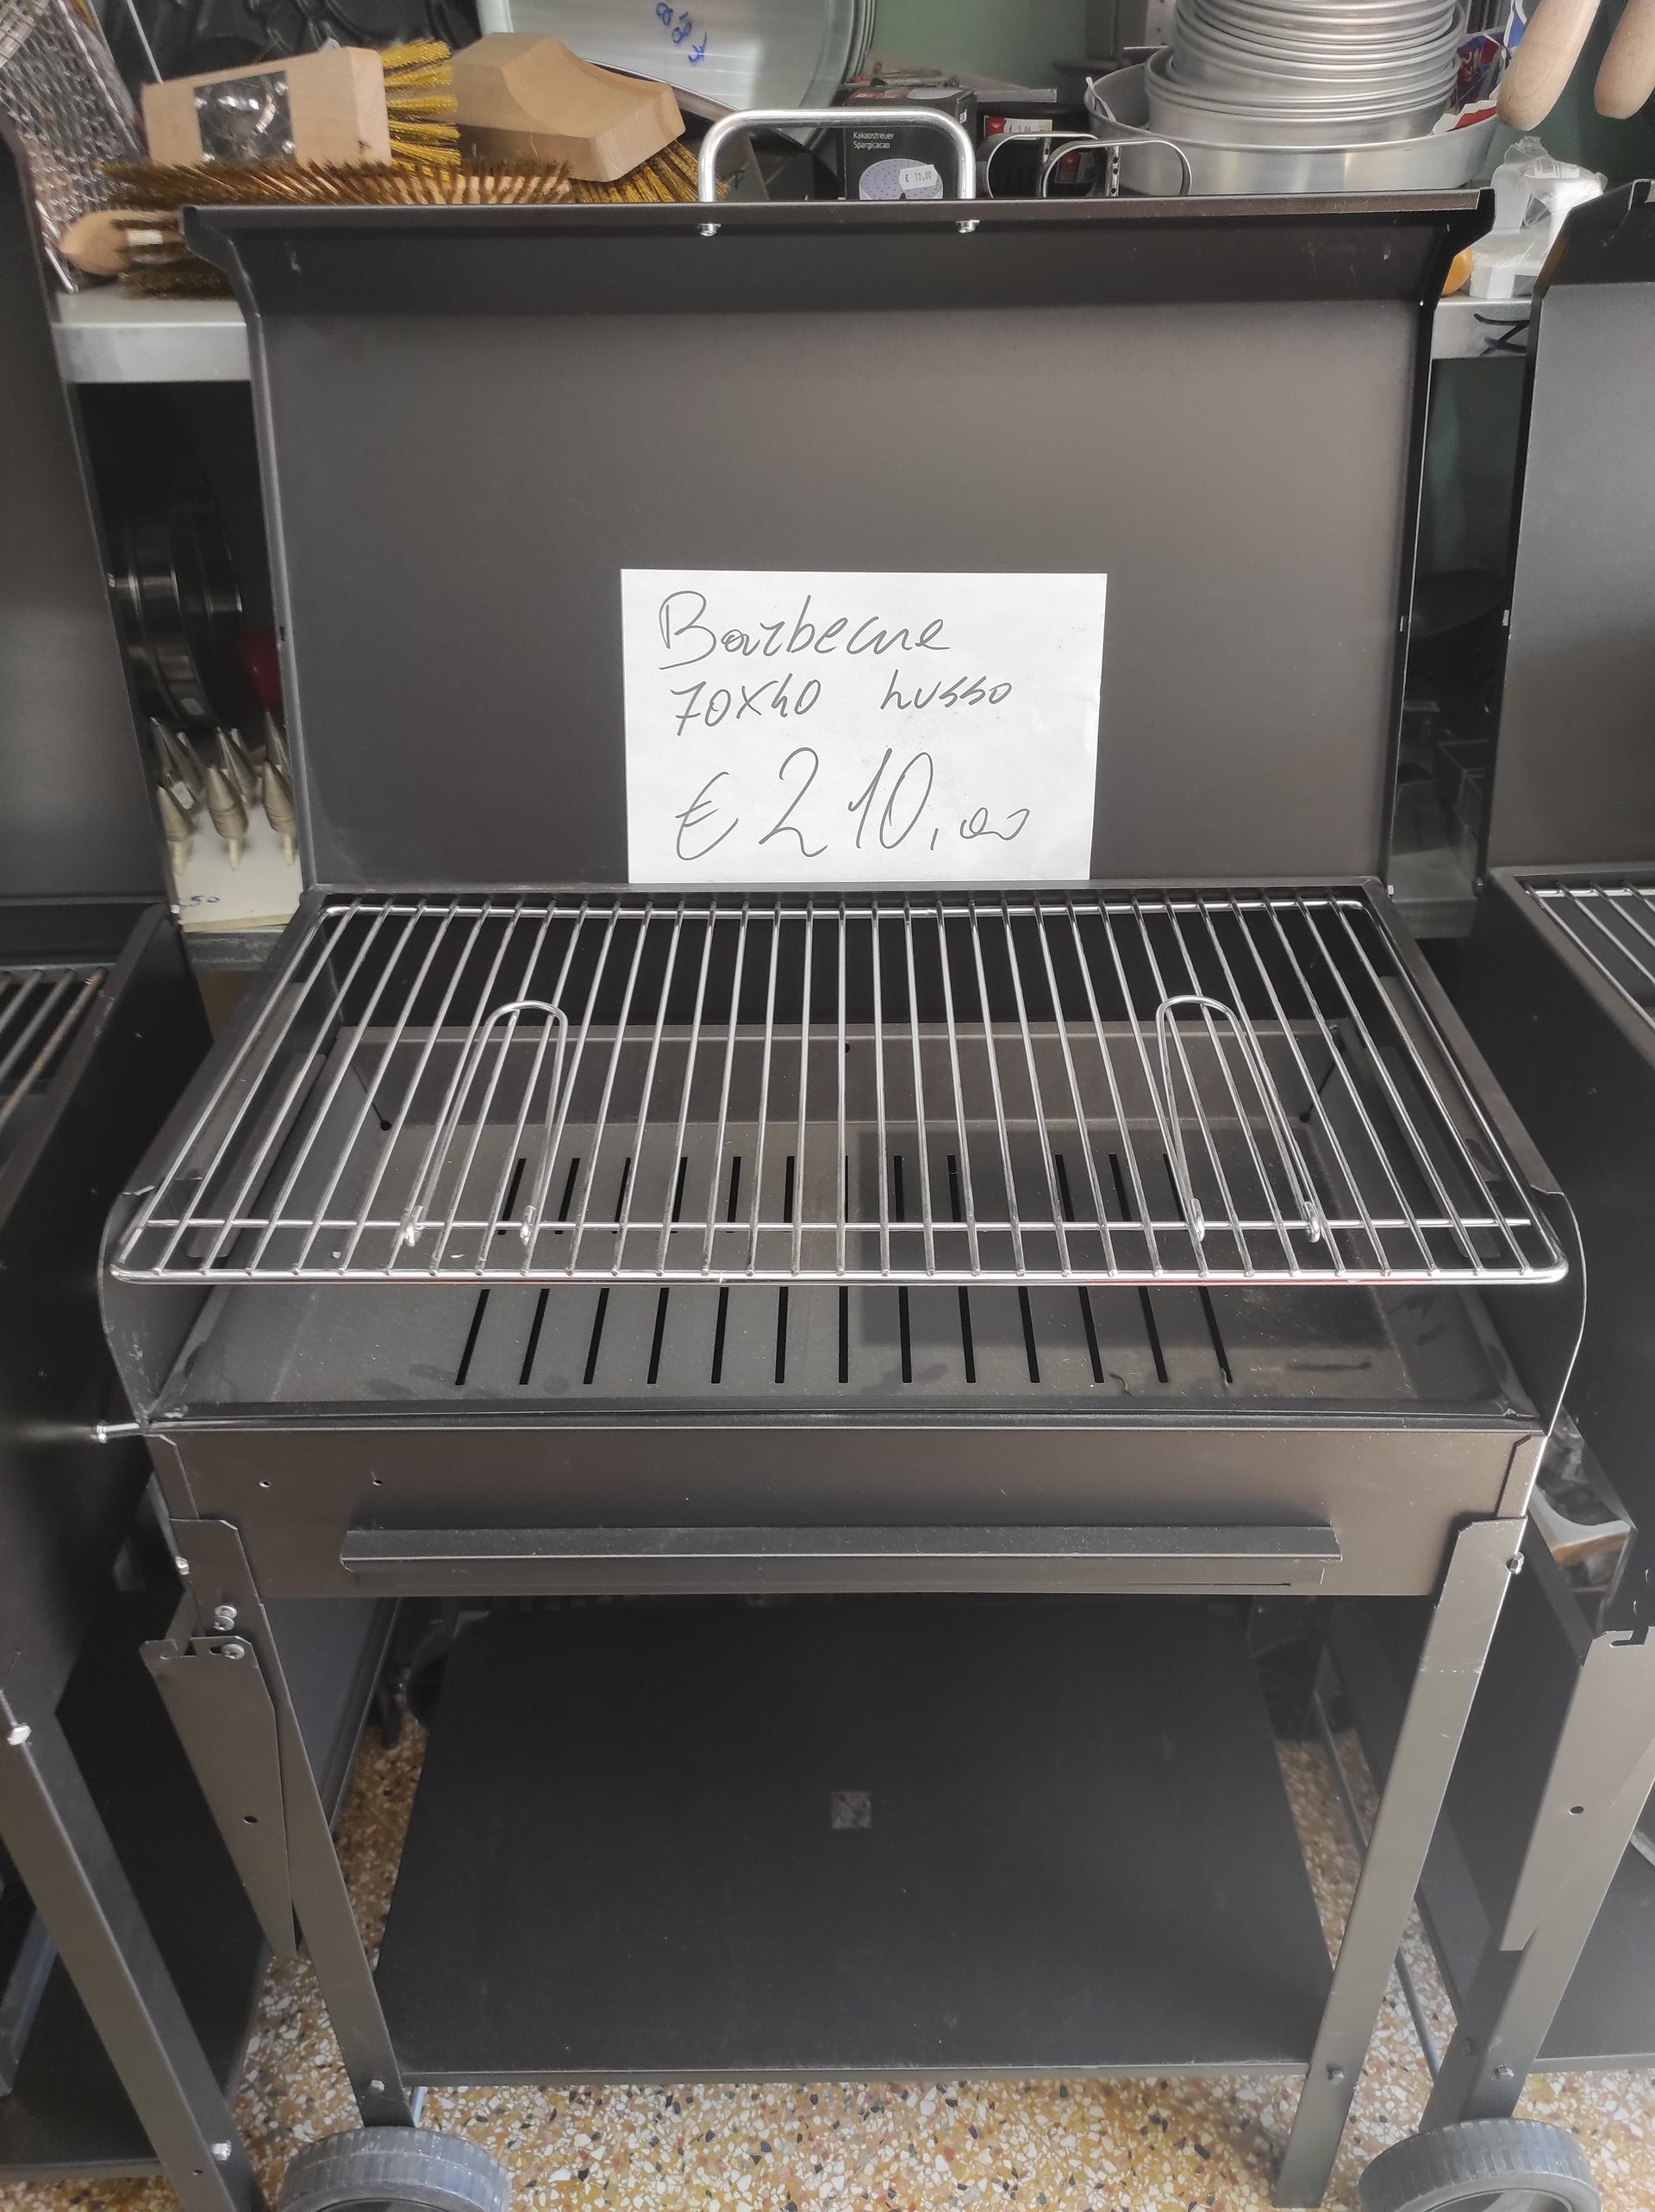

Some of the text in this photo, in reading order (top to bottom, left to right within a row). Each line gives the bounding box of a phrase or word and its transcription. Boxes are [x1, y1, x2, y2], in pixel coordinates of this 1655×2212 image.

[852, 141, 891, 151] Spargicacao
[853, 130, 895, 140] Kakaostreuer
[659, 590, 951, 671] Barbecue
[674, 771, 739, 861] €
